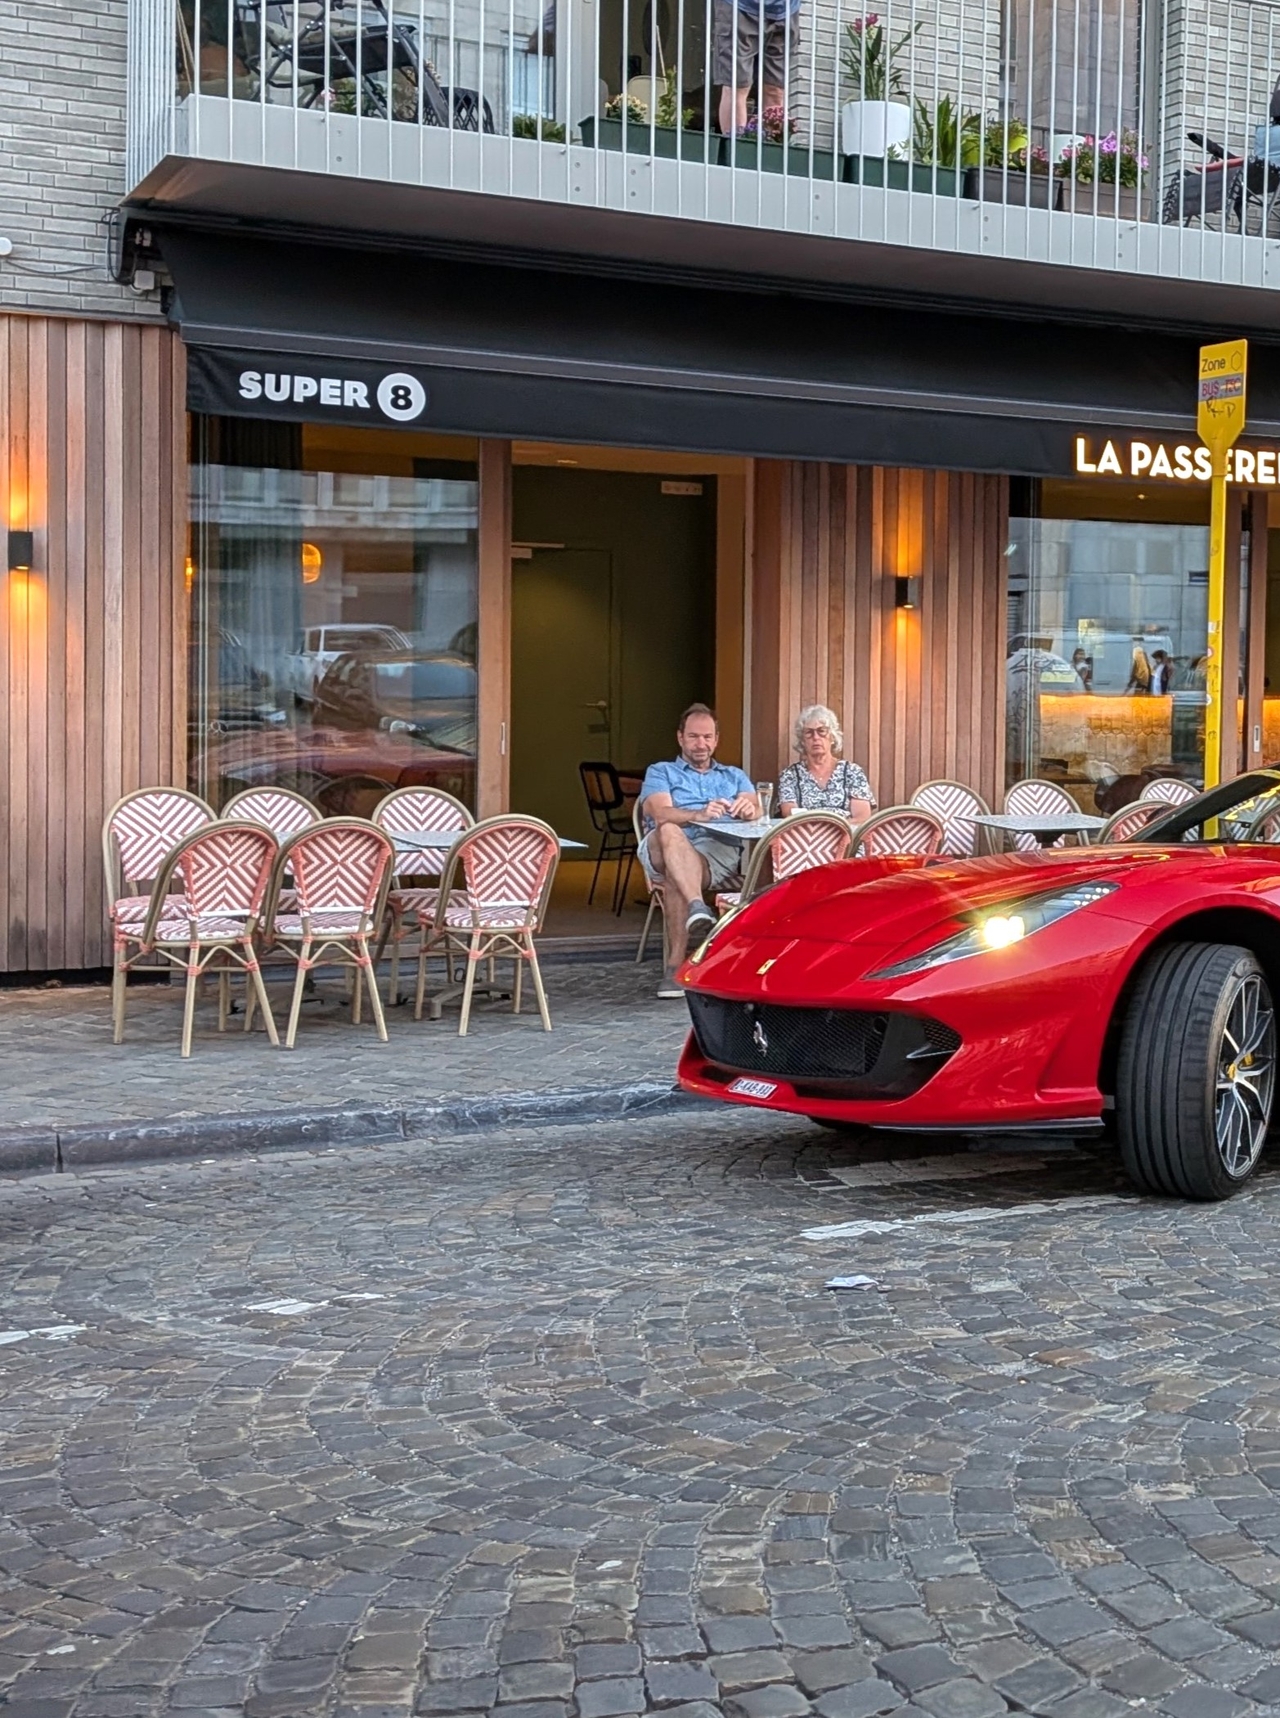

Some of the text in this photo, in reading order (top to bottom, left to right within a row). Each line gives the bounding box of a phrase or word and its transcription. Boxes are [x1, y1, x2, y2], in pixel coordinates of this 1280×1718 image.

[1201, 358, 1226, 372] Zone
[238, 370, 371, 408] SUPER
[1201, 381, 1219, 397] BUS
[1076, 437, 1122, 474] LA
